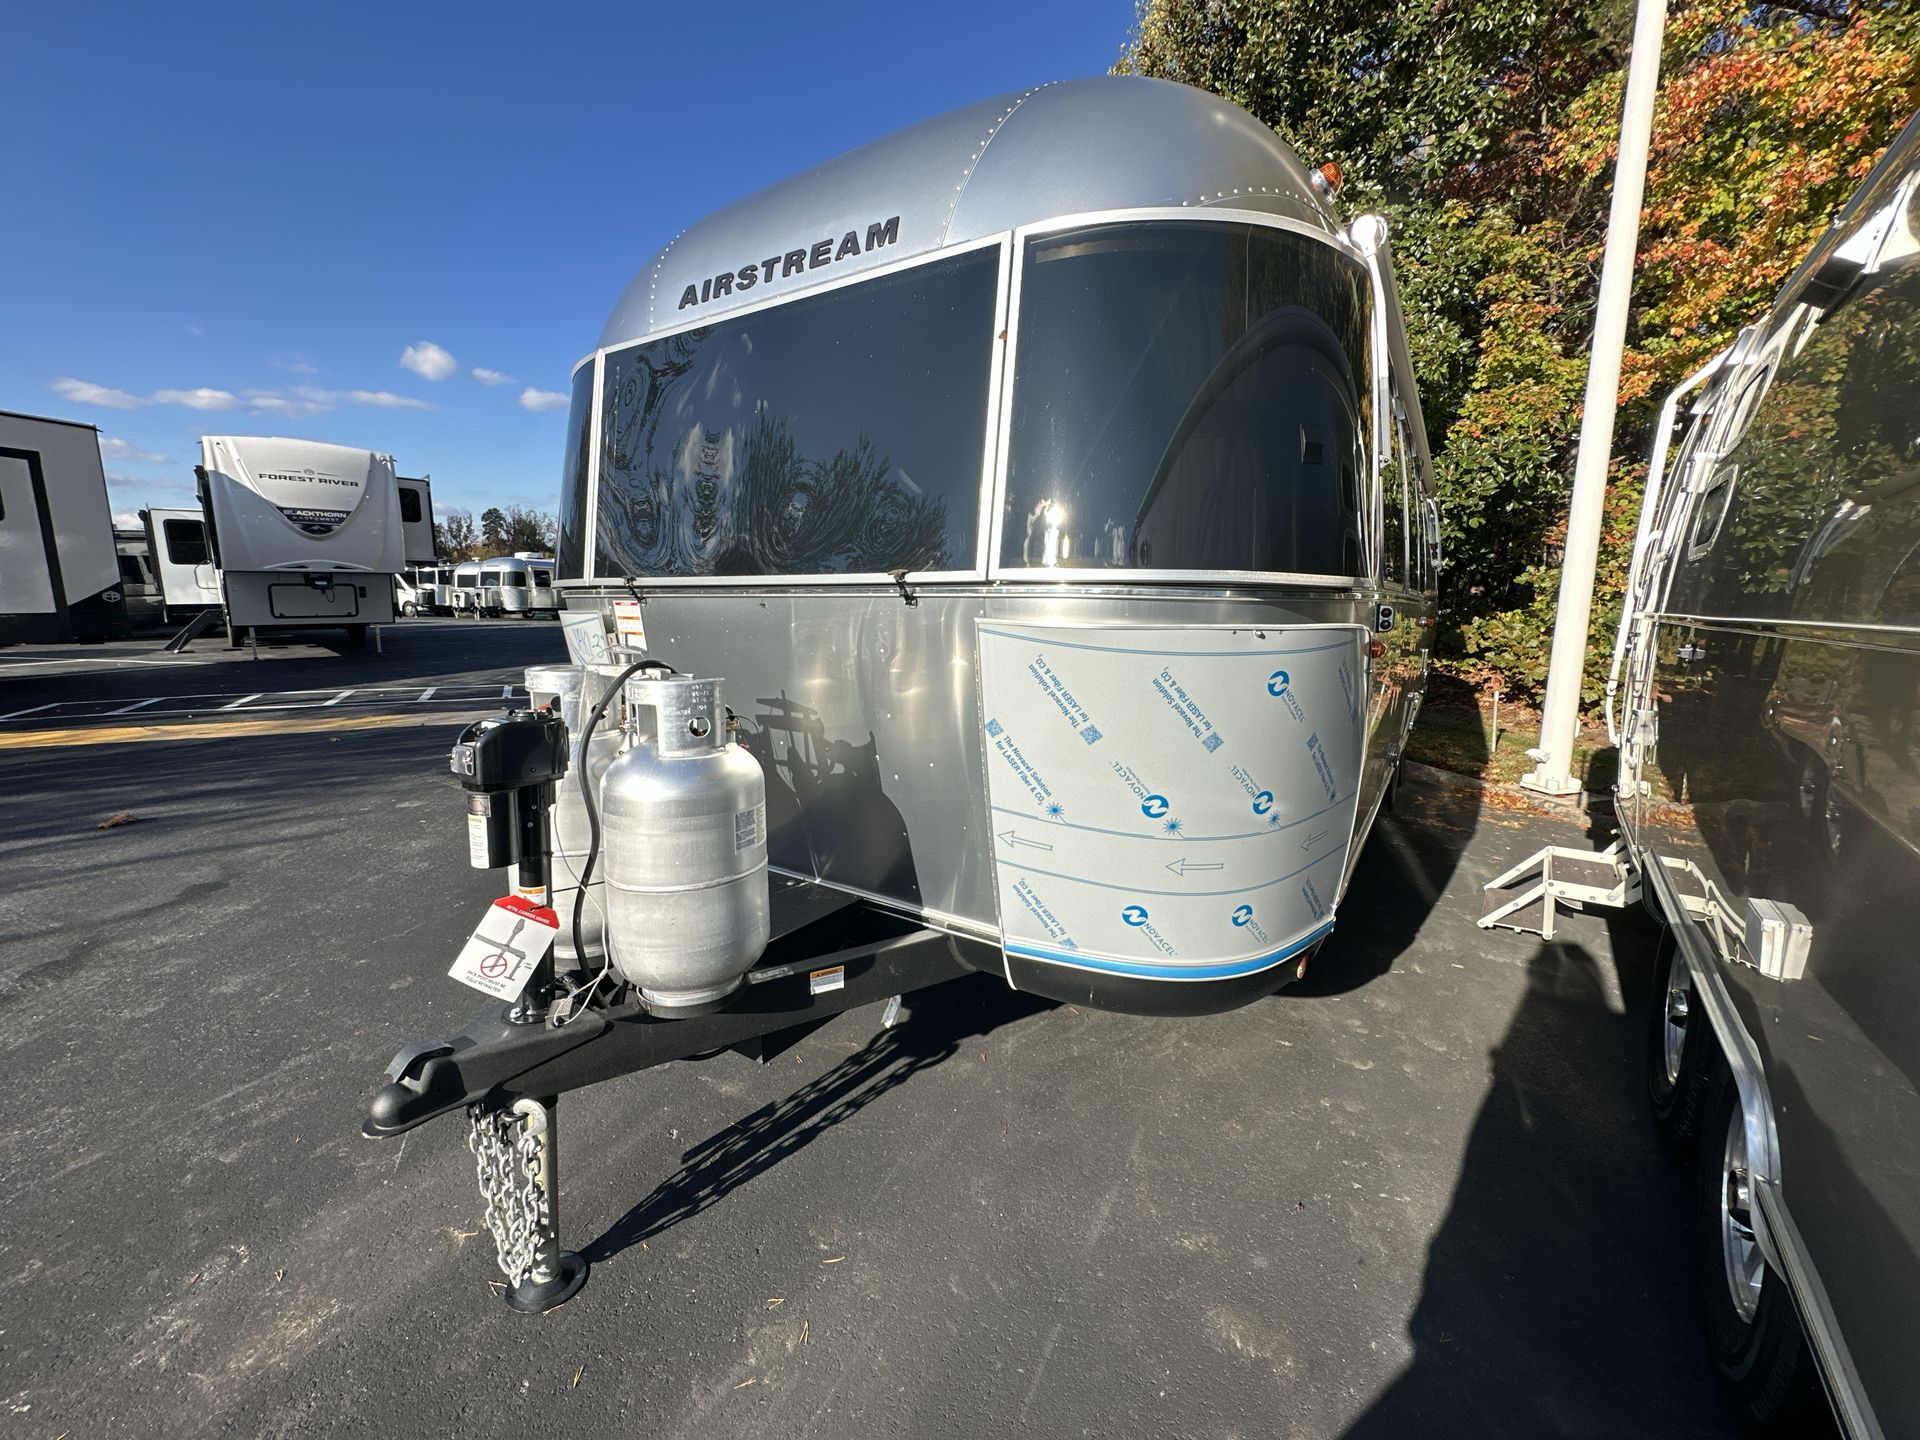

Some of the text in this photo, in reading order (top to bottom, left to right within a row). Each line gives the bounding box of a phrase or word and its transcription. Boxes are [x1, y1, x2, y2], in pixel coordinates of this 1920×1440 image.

[678, 216, 900, 310] AIRSTREAM
[258, 474, 359, 487] FOREST RIVER
[283, 510, 347, 518] BLACKTHORN
[1029, 664, 1080, 728] The Novacel Solution
[1049, 674, 1064, 692] Fiber
[1174, 687, 1190, 704] Fiber
[1061, 690, 1081, 712] LASER
[1152, 678, 1203, 738] The Novacel Solution
[1186, 701, 1206, 722] LASER
[1285, 690, 1304, 723] NOVACEL
[1080, 712, 1090, 722] for
[1203, 720, 1213, 731] for
[996, 741, 1005, 750] for
[1002, 750, 1020, 772] LASER
[1018, 771, 1032, 787] Fiber
[1004, 735, 1052, 797] The Novacel Solution
[1112, 762, 1146, 799] NOVACEL
[1231, 765, 1257, 798] NOVACEL
[1144, 923, 1174, 956] NOVACEL
[1249, 919, 1270, 944] NOVACEL
